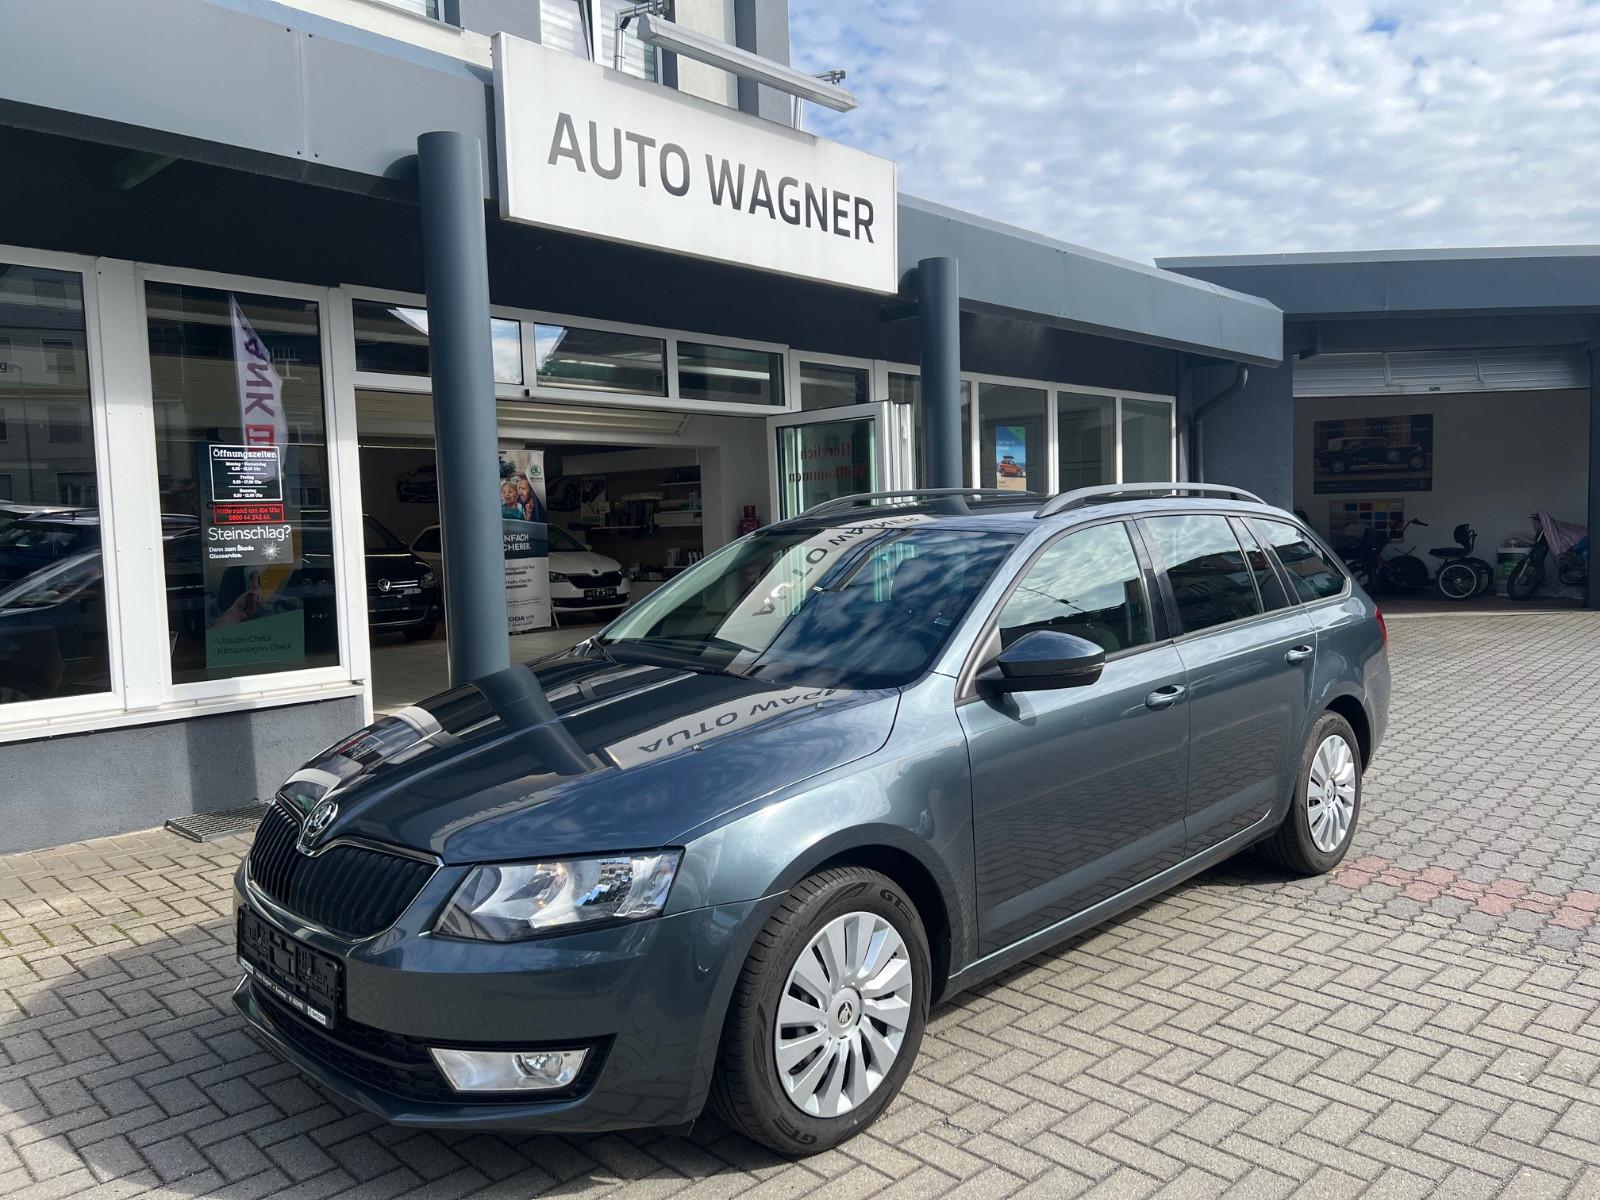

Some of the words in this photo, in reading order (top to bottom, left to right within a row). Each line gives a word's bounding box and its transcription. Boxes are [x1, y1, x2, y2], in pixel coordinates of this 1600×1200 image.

[548, 112, 690, 197] AUTO
[705, 153, 875, 244] WAGNER
[213, 449, 277, 459] Öffnungszeiten
[208, 525, 291, 541] Steinschlag?
